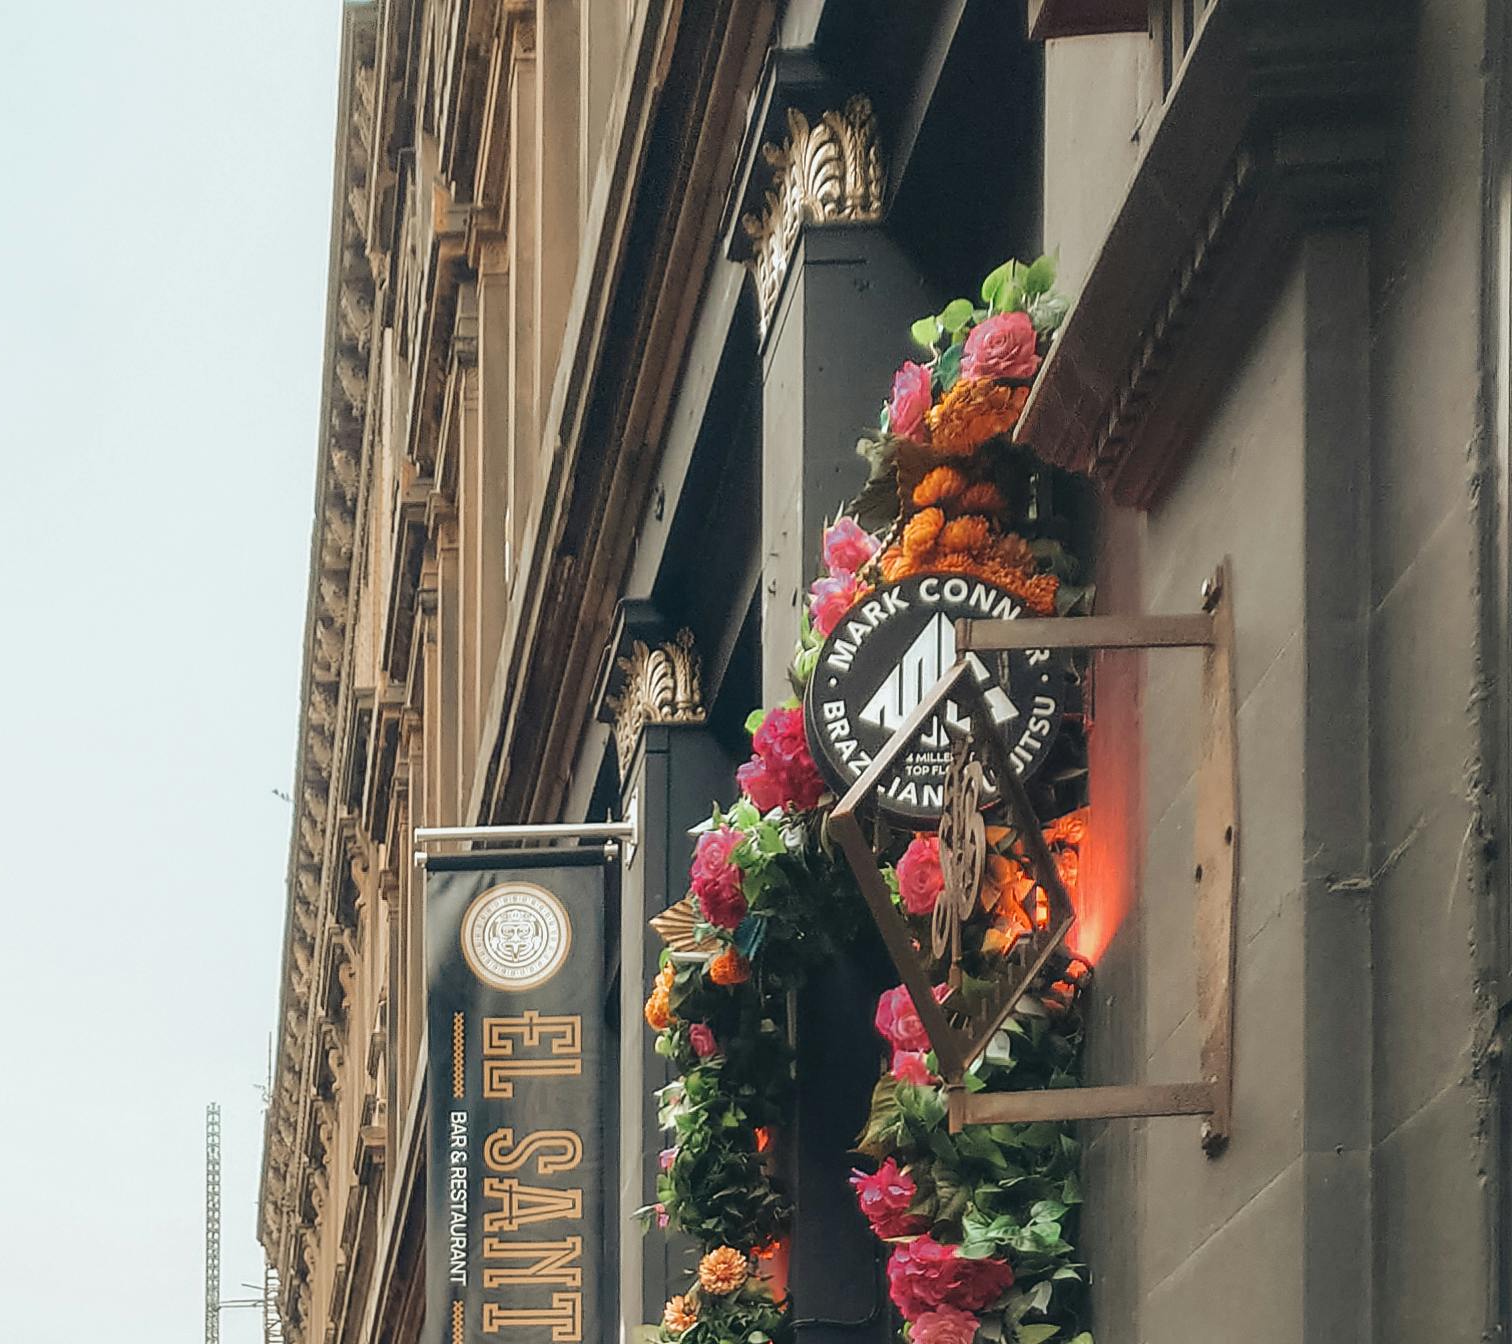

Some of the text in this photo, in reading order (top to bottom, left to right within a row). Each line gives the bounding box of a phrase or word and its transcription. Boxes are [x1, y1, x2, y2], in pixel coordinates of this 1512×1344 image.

[828, 577, 1051, 672] MARK CONNR
[822, 699, 944, 808] BRAZIAN
[904, 765, 930, 776] TOP
[916, 752, 954, 763] MILLE
[483, 1010, 582, 1098] EL
[450, 1111, 468, 1287] BAR & RESTAURANT
